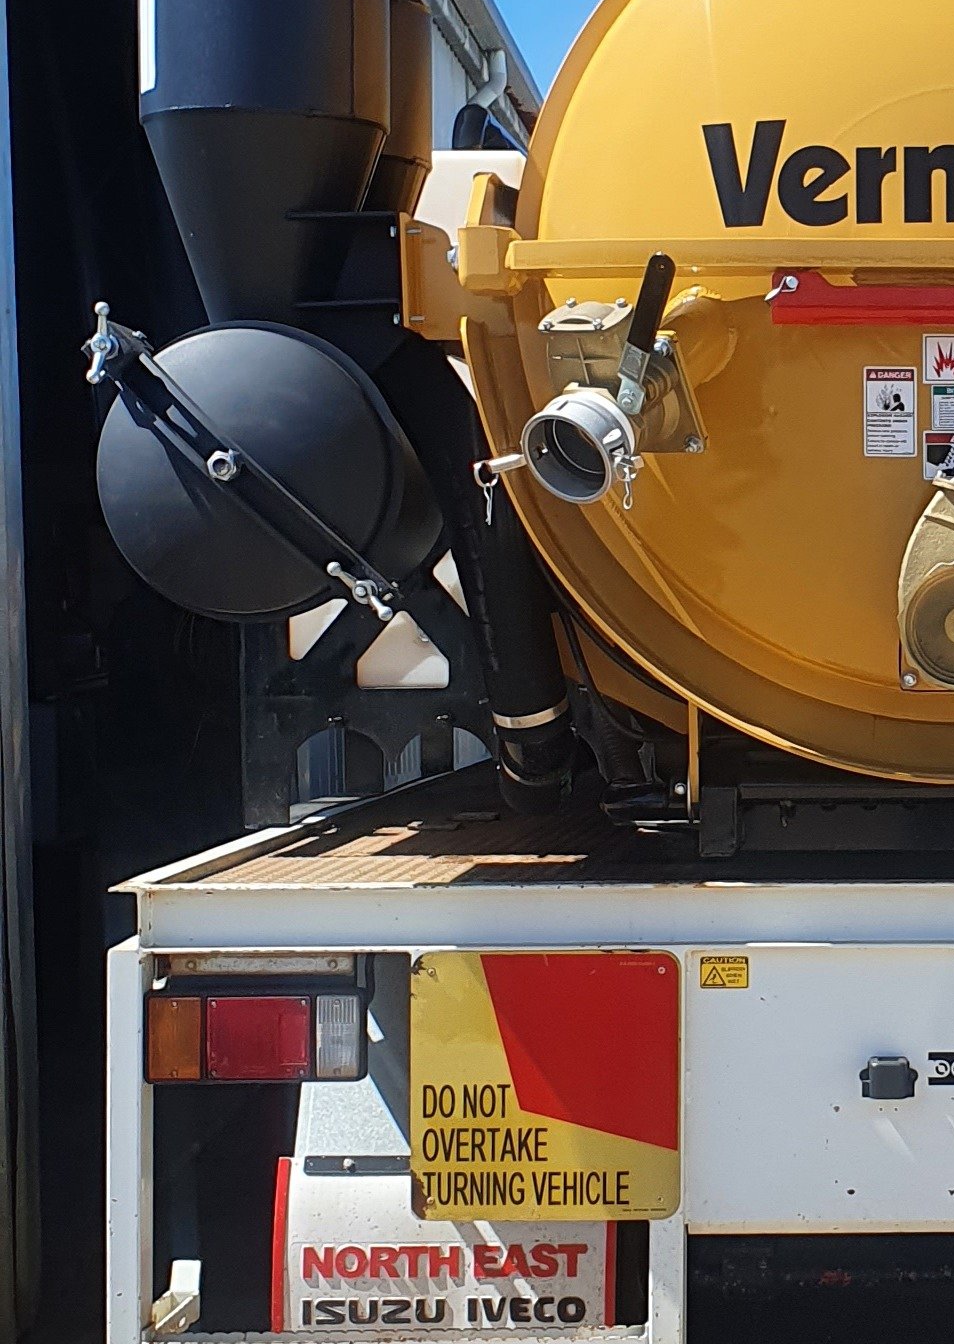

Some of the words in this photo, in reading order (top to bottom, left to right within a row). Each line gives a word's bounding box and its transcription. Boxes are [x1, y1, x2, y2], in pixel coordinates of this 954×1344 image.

[878, 371, 912, 379] DANGER
[422, 1084, 456, 1118] DO
[462, 1083, 511, 1118] NOT
[422, 1127, 548, 1162] OVERTAKE
[422, 1171, 525, 1206] TURNING
[531, 1170, 630, 1206] VEHICLE
[302, 1245, 461, 1278] NORTH
[473, 1243, 588, 1278] EAST
[302, 1297, 446, 1325] ISUZU
[467, 1296, 587, 1323] IVECO
